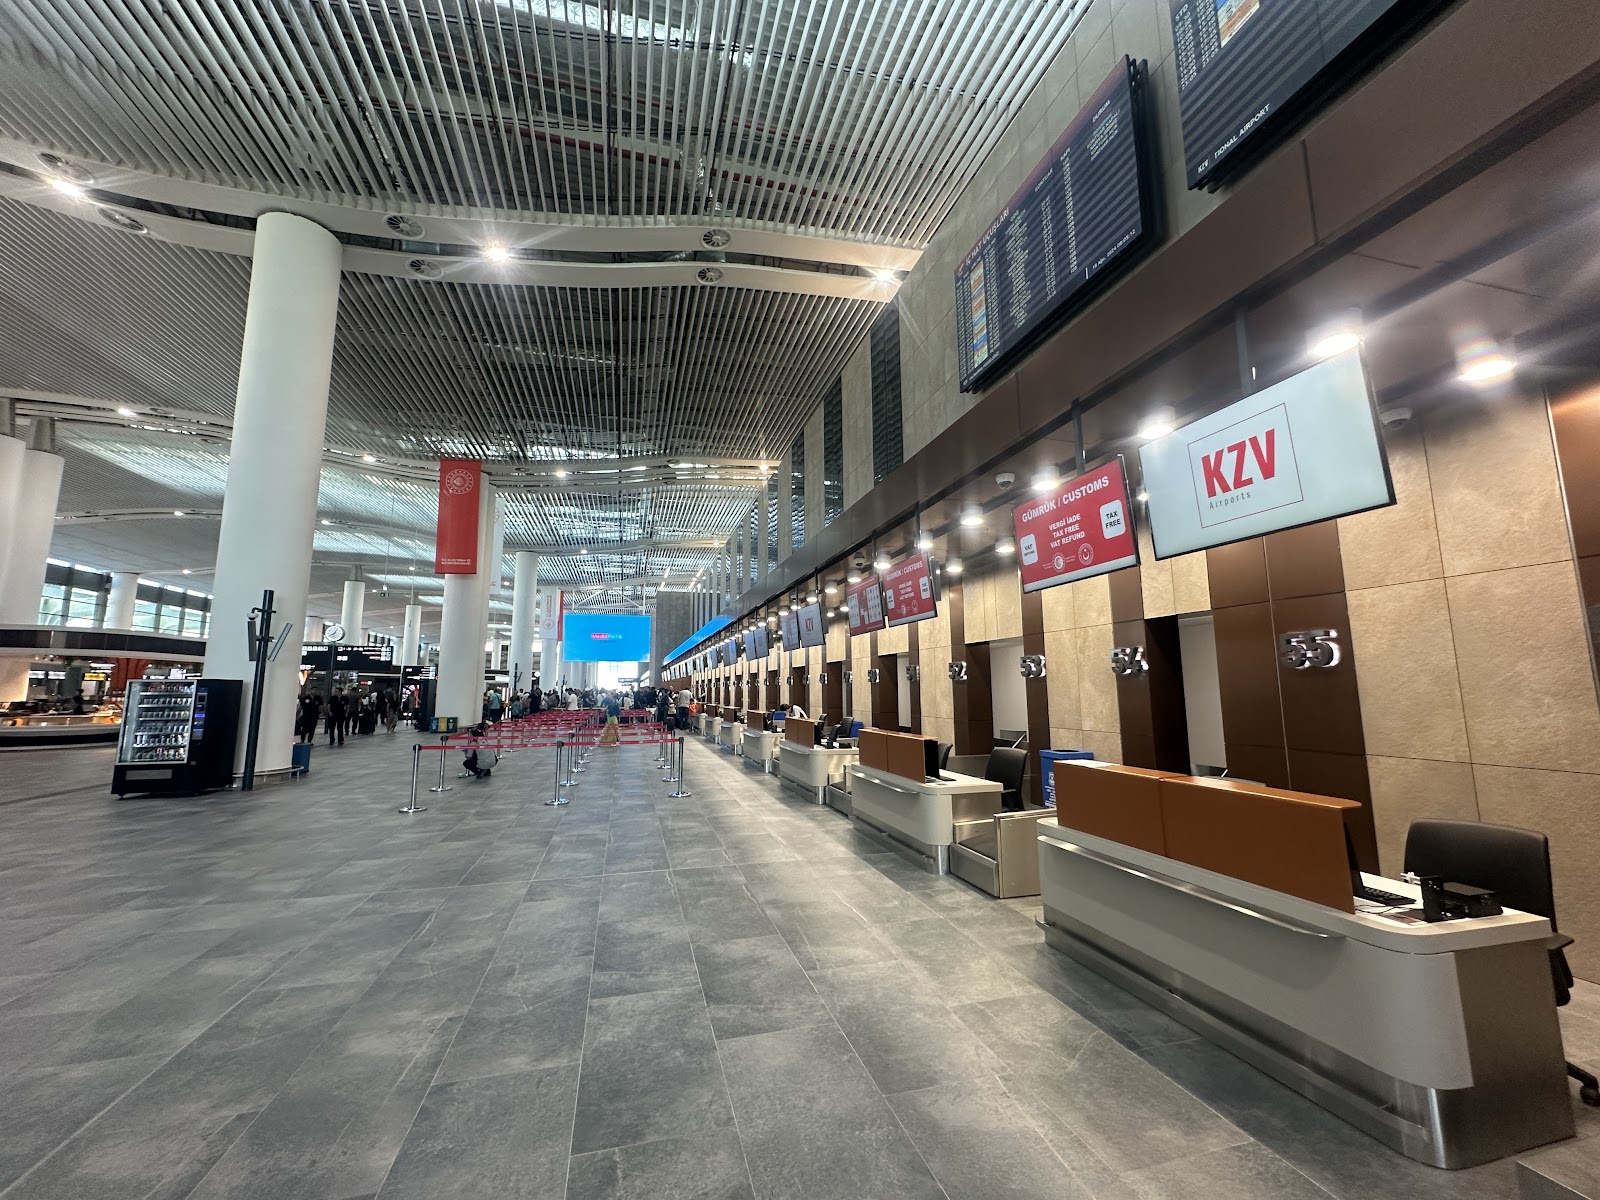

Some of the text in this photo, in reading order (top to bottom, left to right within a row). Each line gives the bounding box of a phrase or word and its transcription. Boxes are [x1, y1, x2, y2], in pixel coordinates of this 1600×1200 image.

[1239, 104, 1270, 136] AIRPORT
[972, 240, 982, 258] HAT
[1201, 428, 1275, 499] KZV
[1022, 500, 1056, 522] GÜMRÜK
[1062, 476, 1110, 505] CUSTOMS
[1210, 492, 1251, 510] Airports
[1106, 510, 1118, 520] TAX
[1106, 518, 1121, 529] FREE
[1048, 518, 1066, 531] VERGİ
[1052, 524, 1080, 538] TAX FREE
[1050, 531, 1086, 548] VAT REFUND
[904, 561, 922, 574] CUSTOMS
[1280, 629, 1340, 670] 55
[1020, 655, 1046, 678] 53
[1110, 646, 1150, 674] 54
[949, 662, 968, 680] 52
